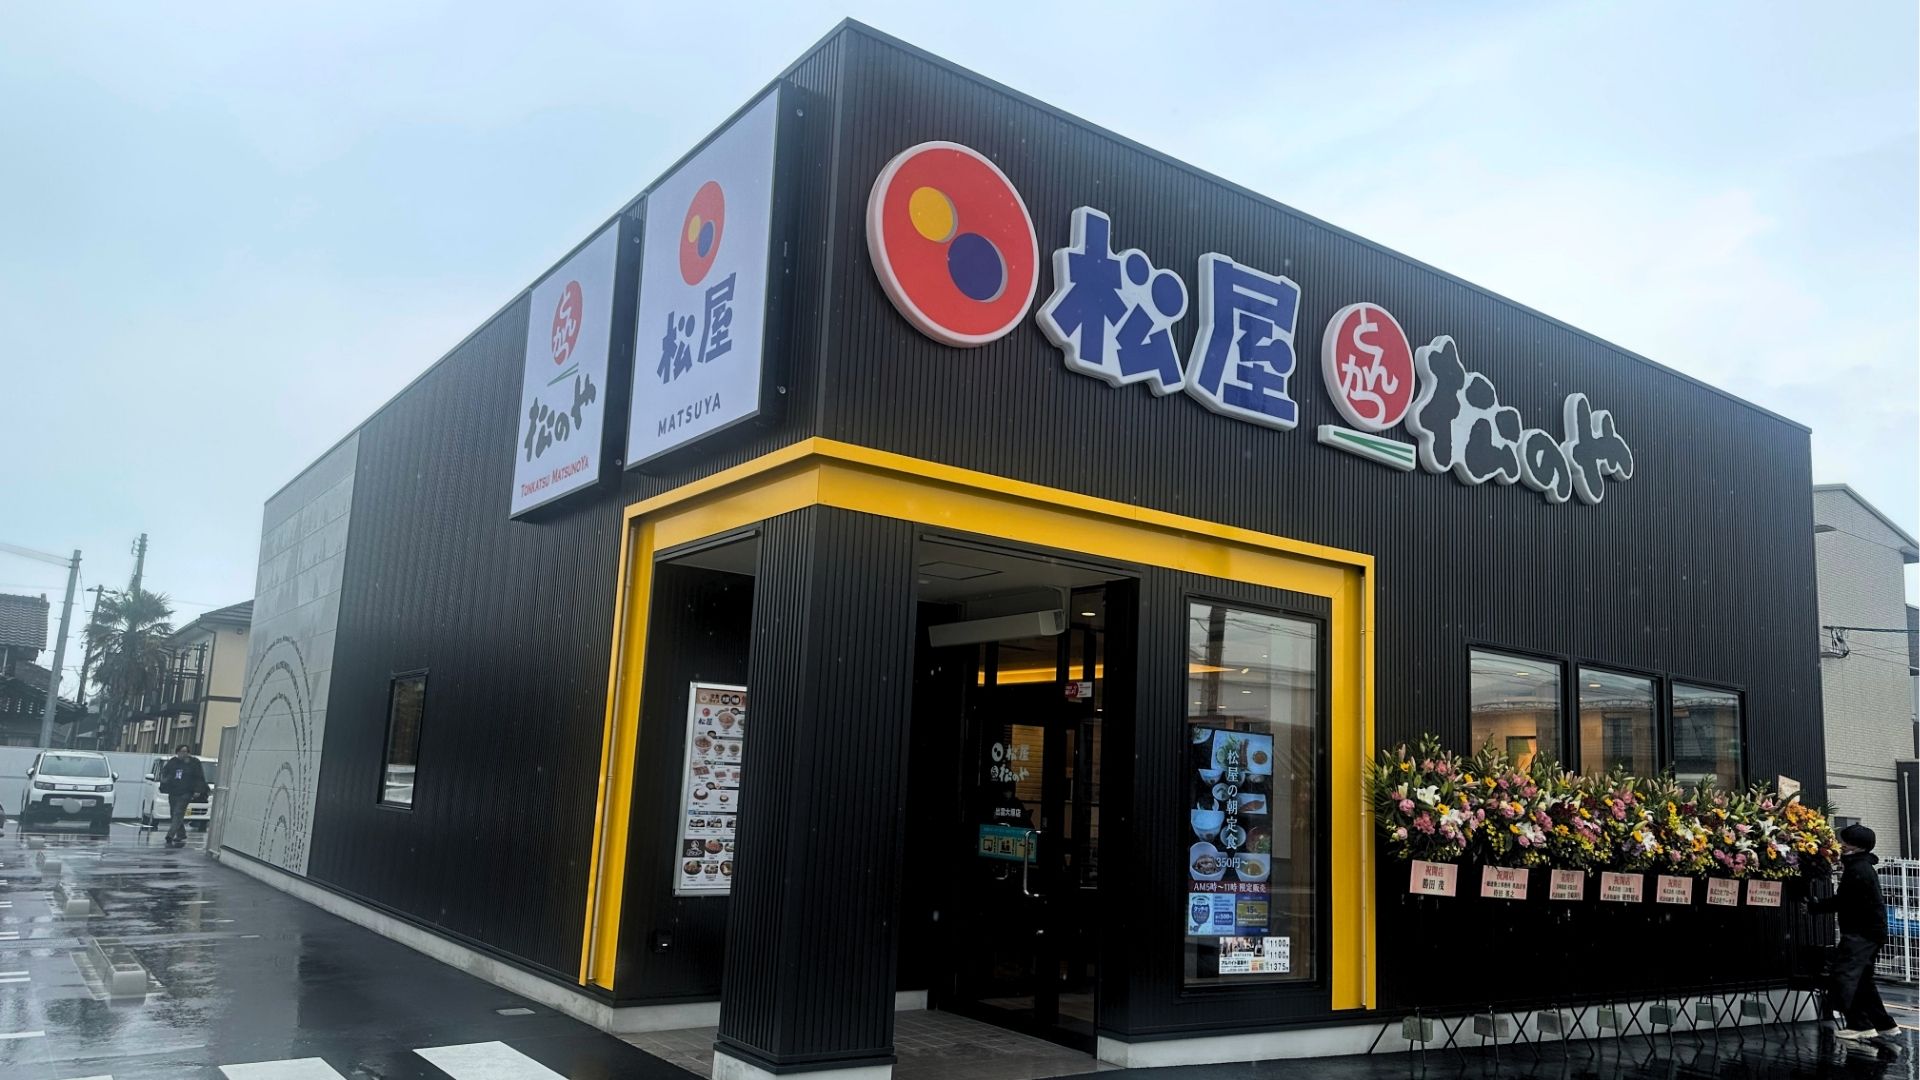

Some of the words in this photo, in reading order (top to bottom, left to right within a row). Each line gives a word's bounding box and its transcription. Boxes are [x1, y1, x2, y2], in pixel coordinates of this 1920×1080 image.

[552, 285, 580, 361] とんかつ
[657, 272, 737, 385] 松屋
[1043, 208, 1300, 426] 松屋
[1333, 304, 1405, 428] とんかつ
[524, 373, 596, 463] 松のや
[657, 392, 721, 438] MATSUYA
[1410, 337, 1633, 502] 松のや
[999, 764, 1030, 783] 松のや
[1006, 744, 1030, 761] 松屋
[1226, 749, 1240, 850] 松屋の朝定食
